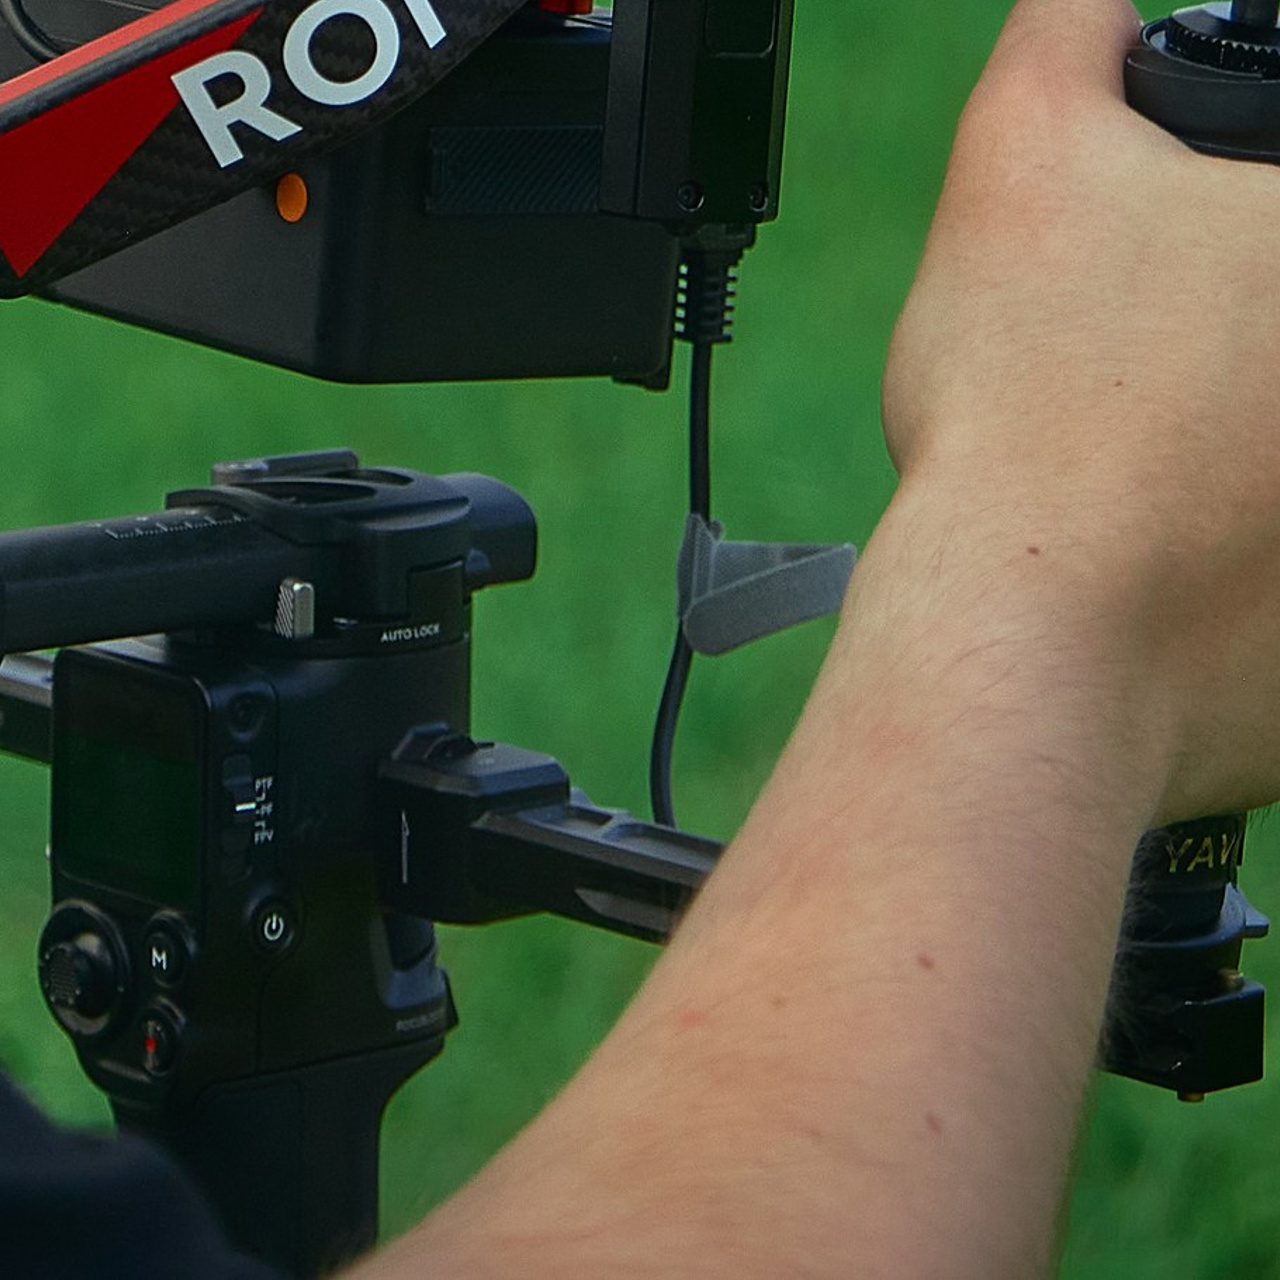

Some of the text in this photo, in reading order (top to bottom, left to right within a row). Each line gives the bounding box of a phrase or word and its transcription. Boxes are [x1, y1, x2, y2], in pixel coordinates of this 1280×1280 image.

[380, 623, 440, 643] AUTO LOCK
[151, 946, 167, 971] M
